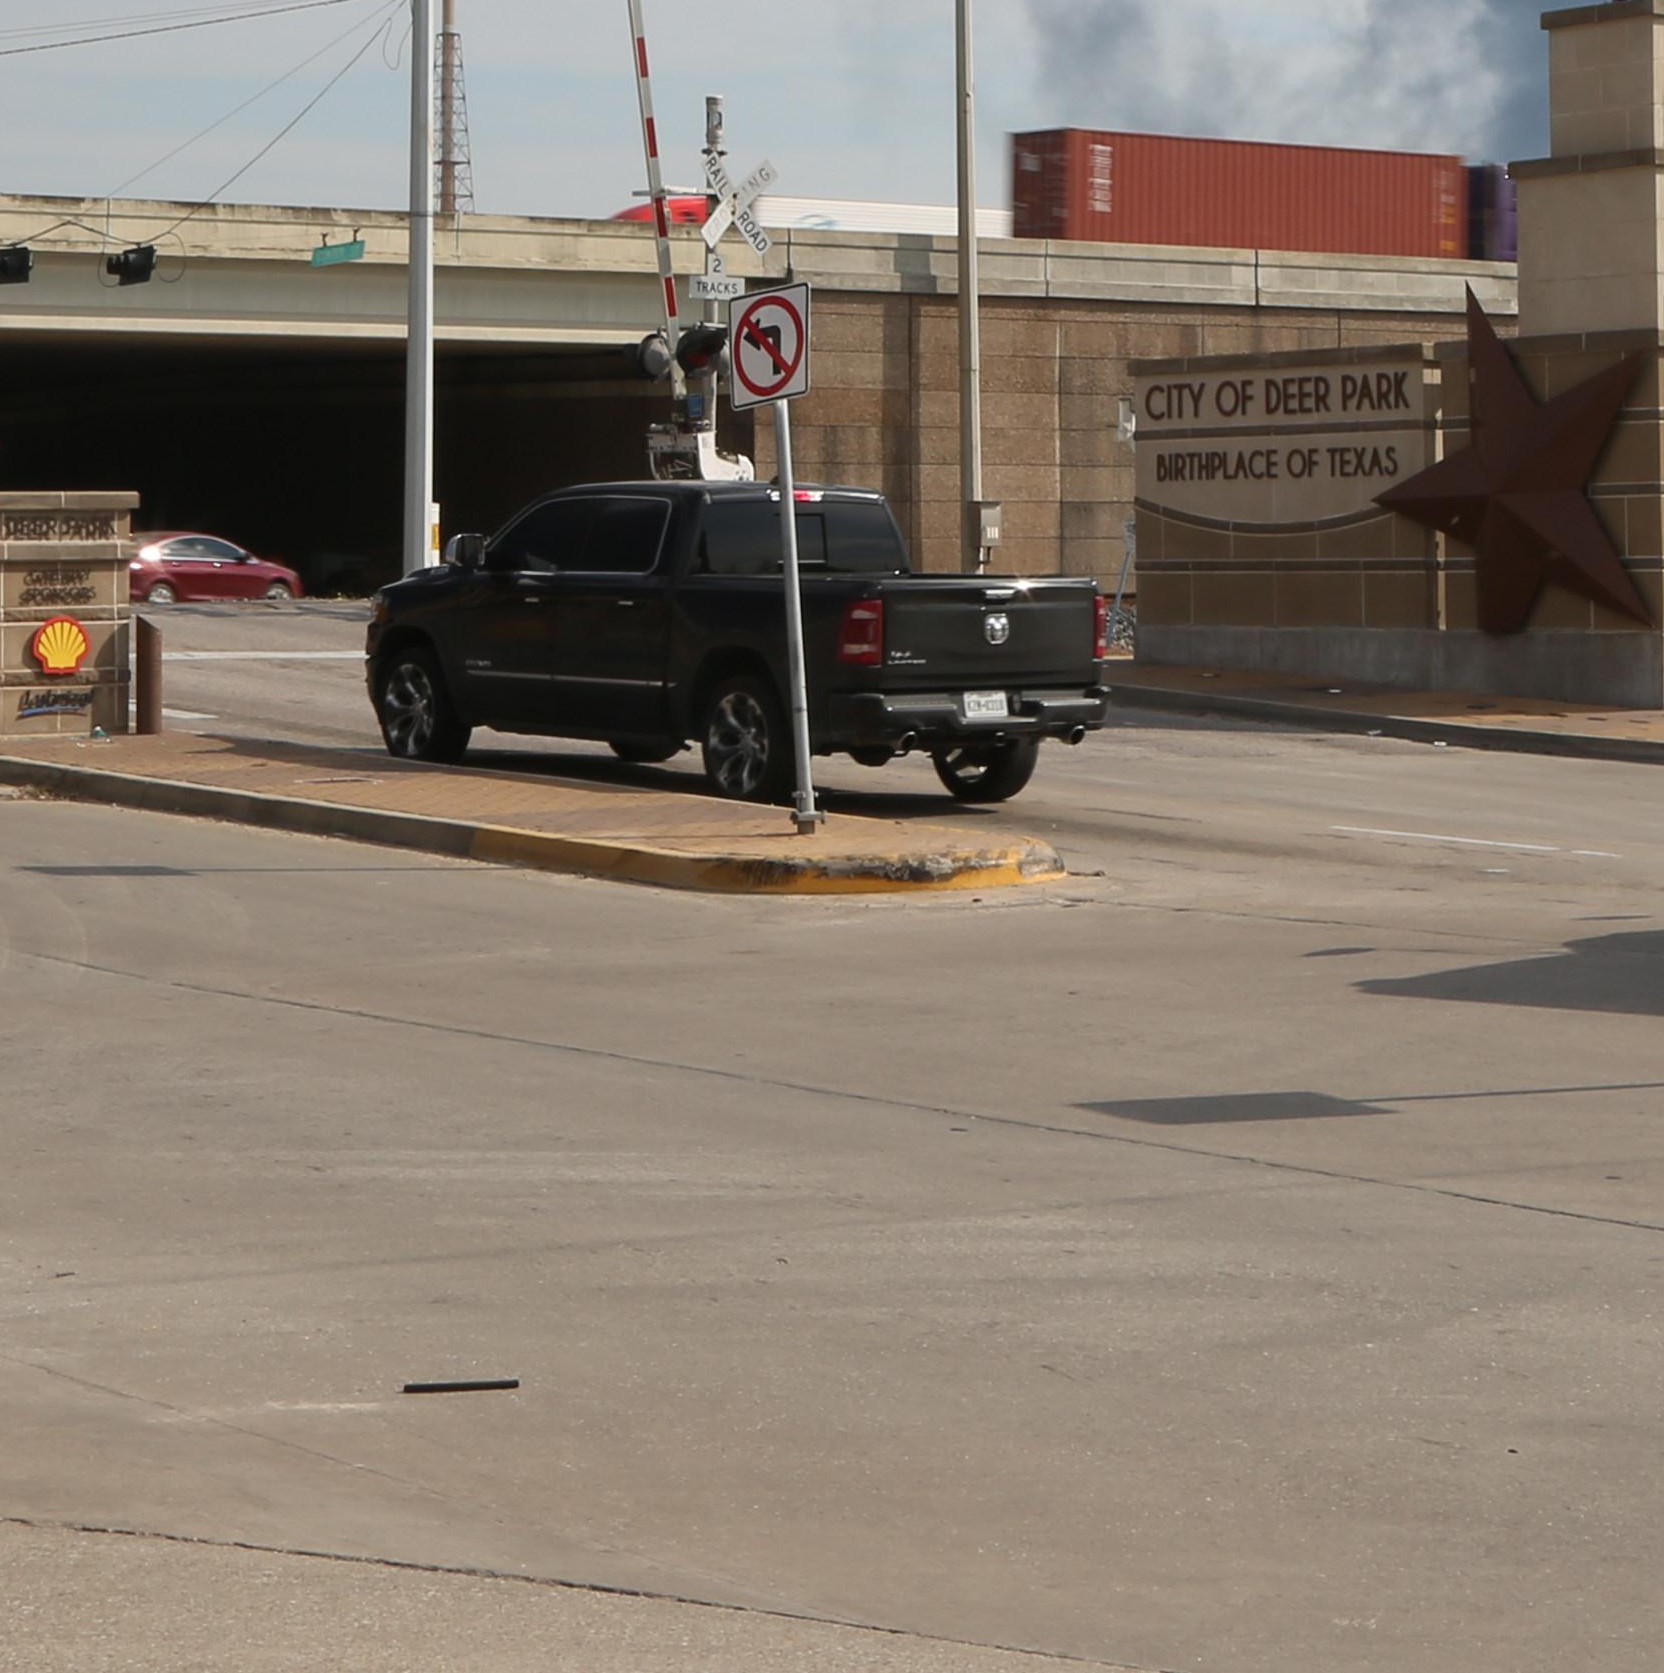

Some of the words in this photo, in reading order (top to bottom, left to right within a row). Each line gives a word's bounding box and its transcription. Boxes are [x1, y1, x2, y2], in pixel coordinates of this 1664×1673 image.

[705, 155, 729, 197] RAIL
[737, 211, 768, 253] ROAD
[712, 258, 722, 273] 2
[696, 281, 738, 295] TRACKS
[1145, 382, 1205, 420] CITY
[1215, 380, 1254, 417] OF
[1265, 376, 1331, 415] DEER
[1341, 372, 1410, 411] PARK
[1156, 450, 1278, 482] BIRTHPLACE
[1286, 448, 1319, 478] OF
[1327, 446, 1398, 477] TEXAS
[4, 516, 56, 539] DEER
[59, 516, 116, 539] PARK
